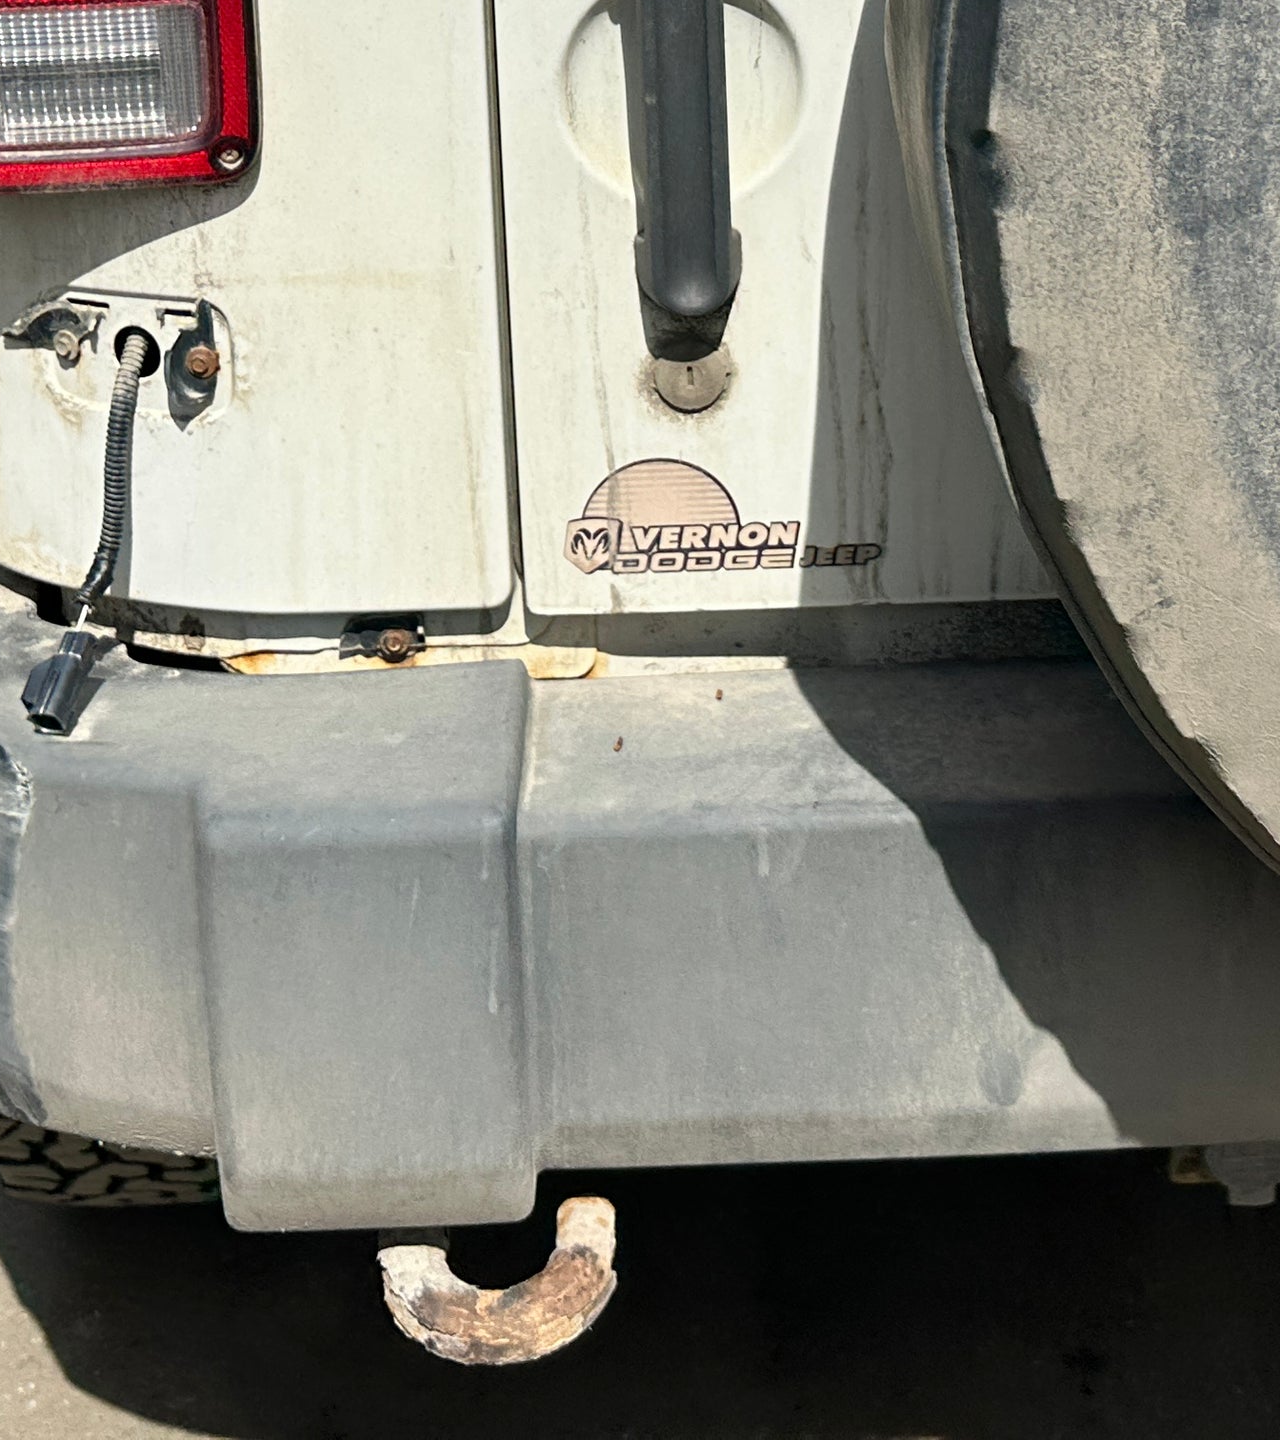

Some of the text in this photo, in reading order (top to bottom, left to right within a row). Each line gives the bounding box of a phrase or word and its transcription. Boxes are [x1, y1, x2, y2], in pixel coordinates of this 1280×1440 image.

[630, 521, 801, 551] VERNON
[611, 543, 883, 574] DODGE JEEP
